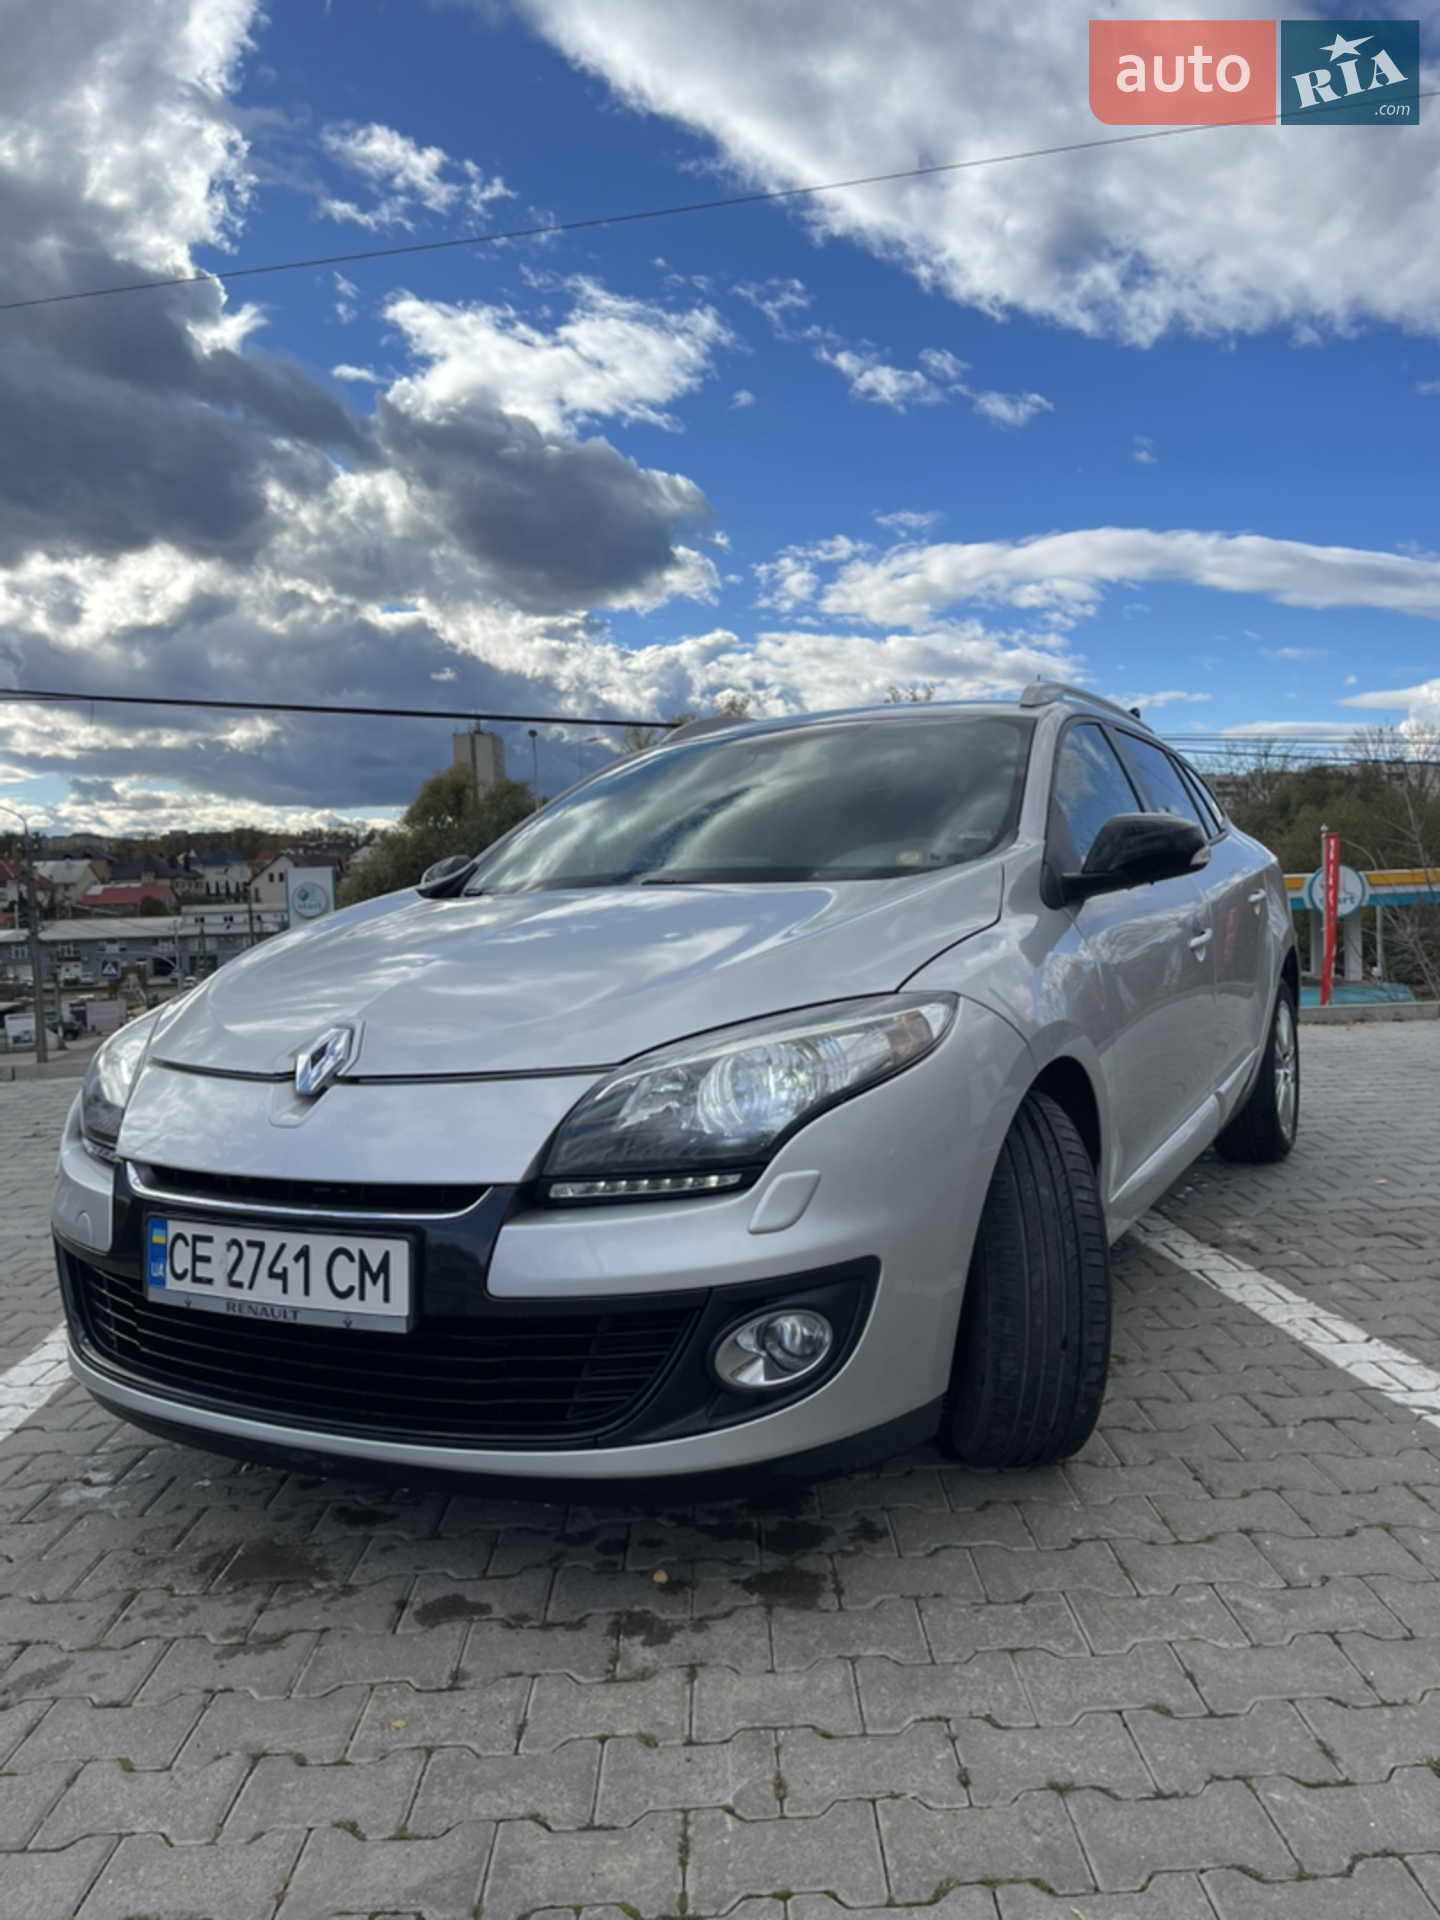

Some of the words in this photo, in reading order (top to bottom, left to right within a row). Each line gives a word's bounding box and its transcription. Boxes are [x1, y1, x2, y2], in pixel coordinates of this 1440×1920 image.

[168, 1232, 214, 1286] CE
[226, 1238, 311, 1297] 2741
[326, 1246, 391, 1303] CM
[227, 1301, 301, 1321] RENAULT
